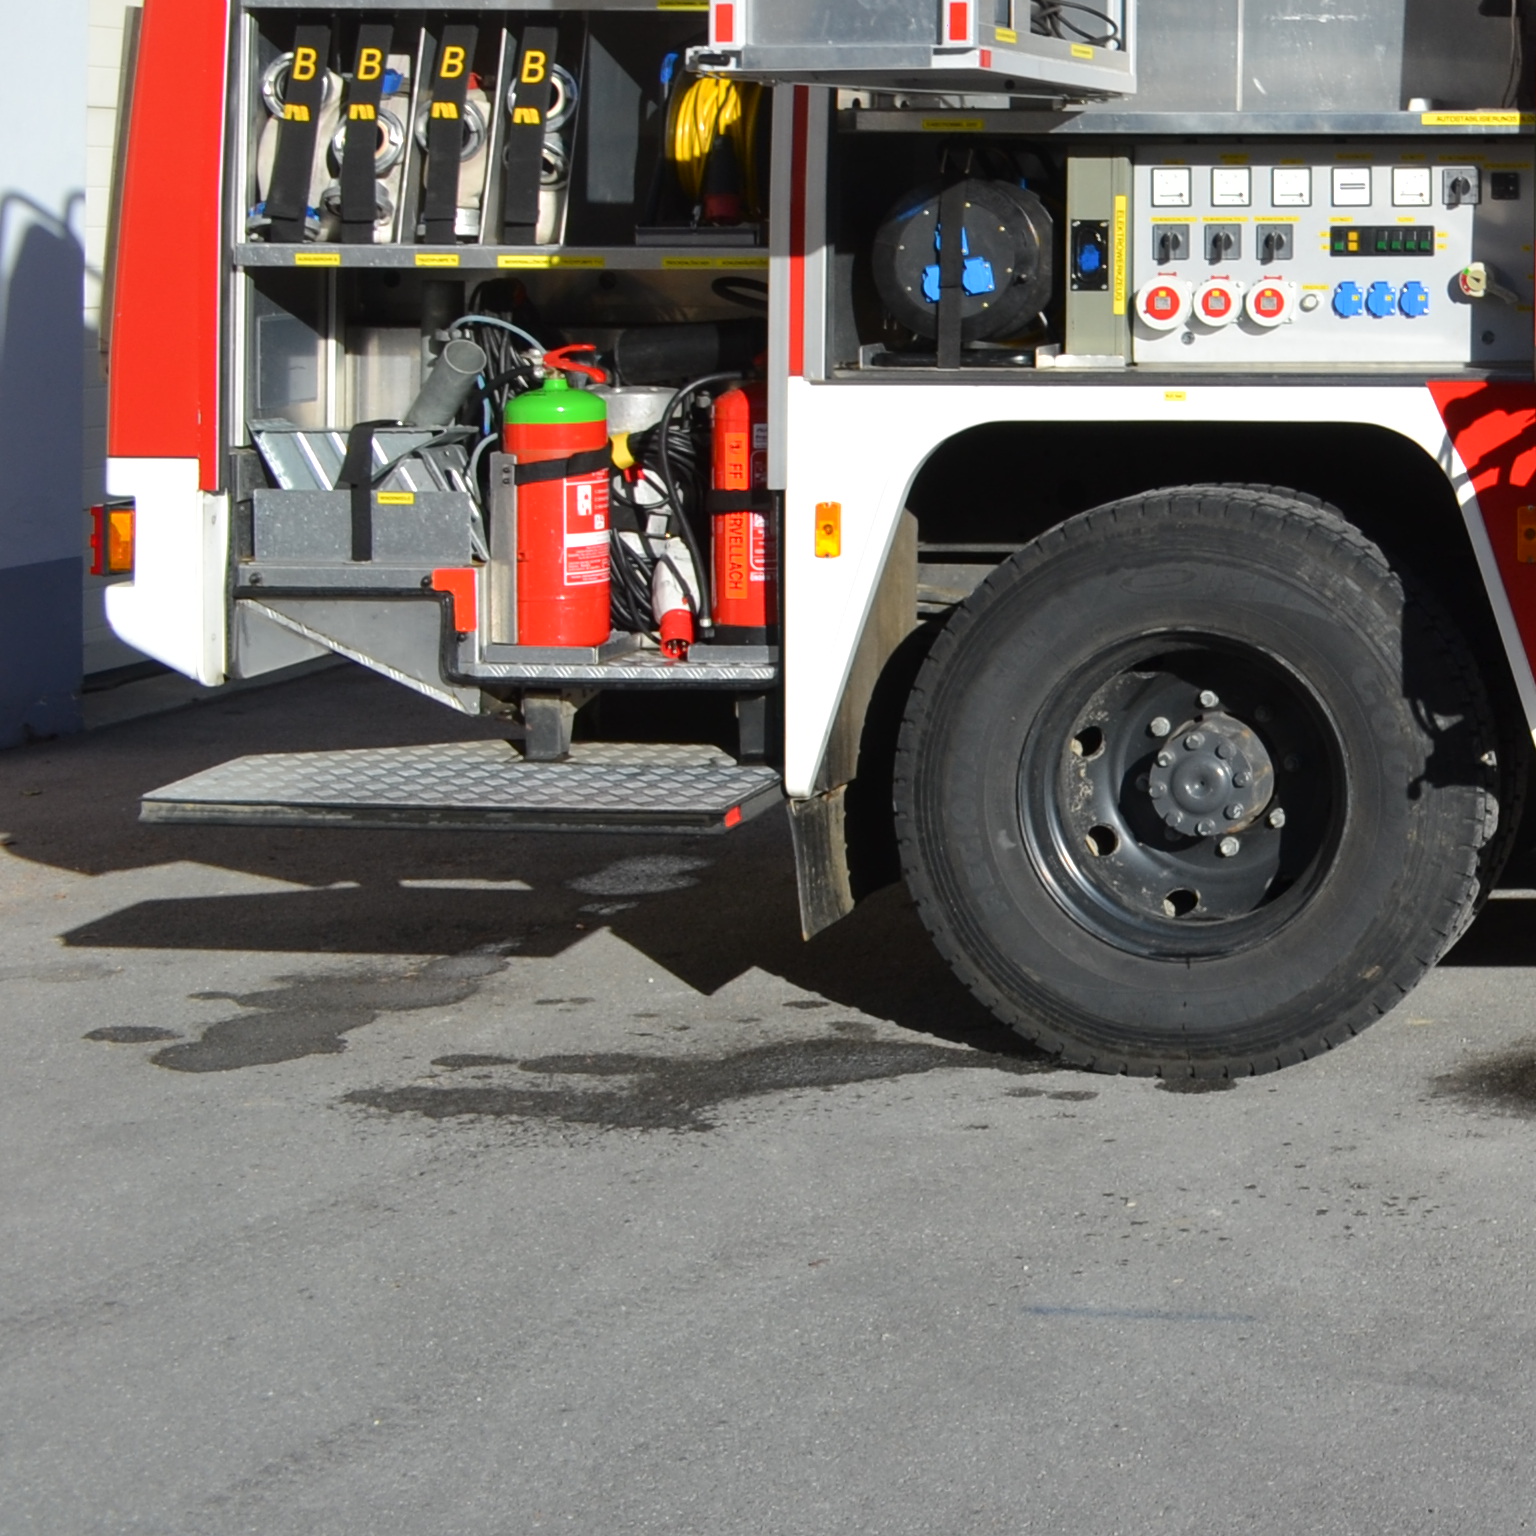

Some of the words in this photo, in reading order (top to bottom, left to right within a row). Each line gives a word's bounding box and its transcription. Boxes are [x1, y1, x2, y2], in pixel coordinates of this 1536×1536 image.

[291, 46, 318, 82] B
[357, 47, 384, 82] B
[439, 45, 466, 80] B
[520, 49, 548, 85] B
